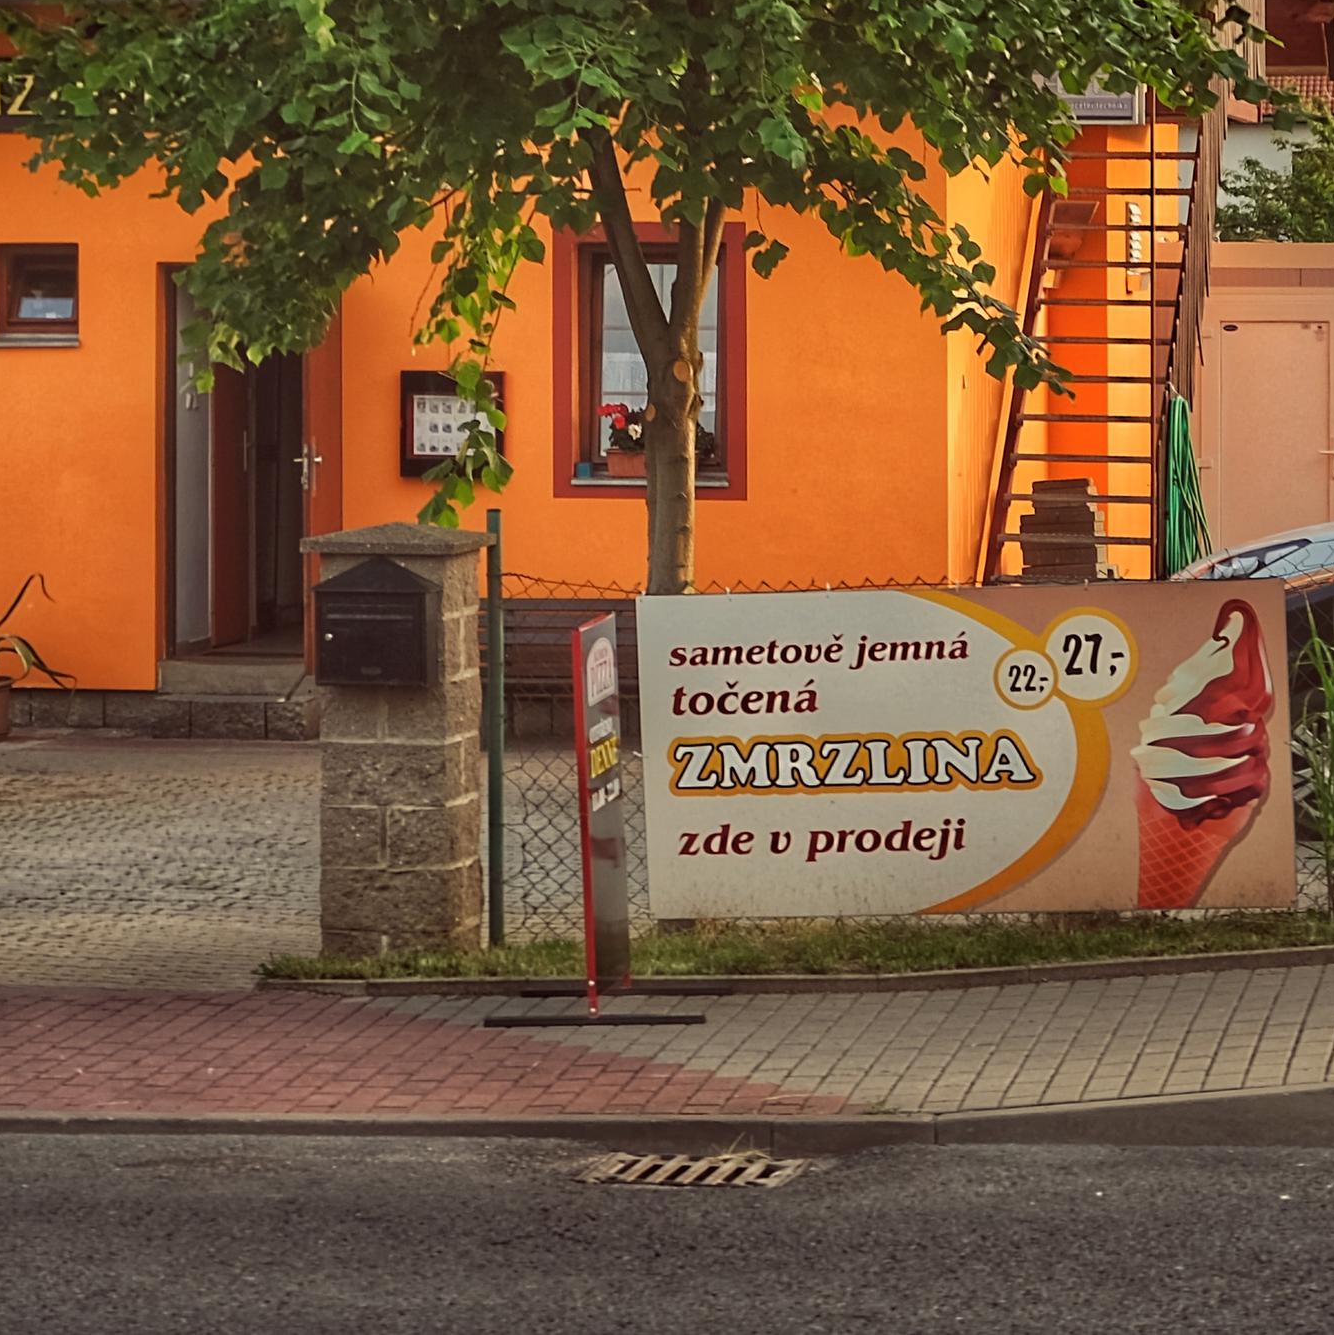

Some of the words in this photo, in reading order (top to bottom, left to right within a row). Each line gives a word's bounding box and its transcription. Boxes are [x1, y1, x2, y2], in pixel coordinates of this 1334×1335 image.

[668, 633, 844, 667] sametově
[848, 631, 969, 670] jemná
[1062, 633, 1124, 676] 27,-
[671, 679, 819, 716] točená
[1008, 664, 1049, 693] 22,-
[673, 735, 1037, 790] ZMRZLINA
[678, 823, 755, 856] zde
[769, 830, 792, 854] v
[805, 818, 967, 863] prodeji
